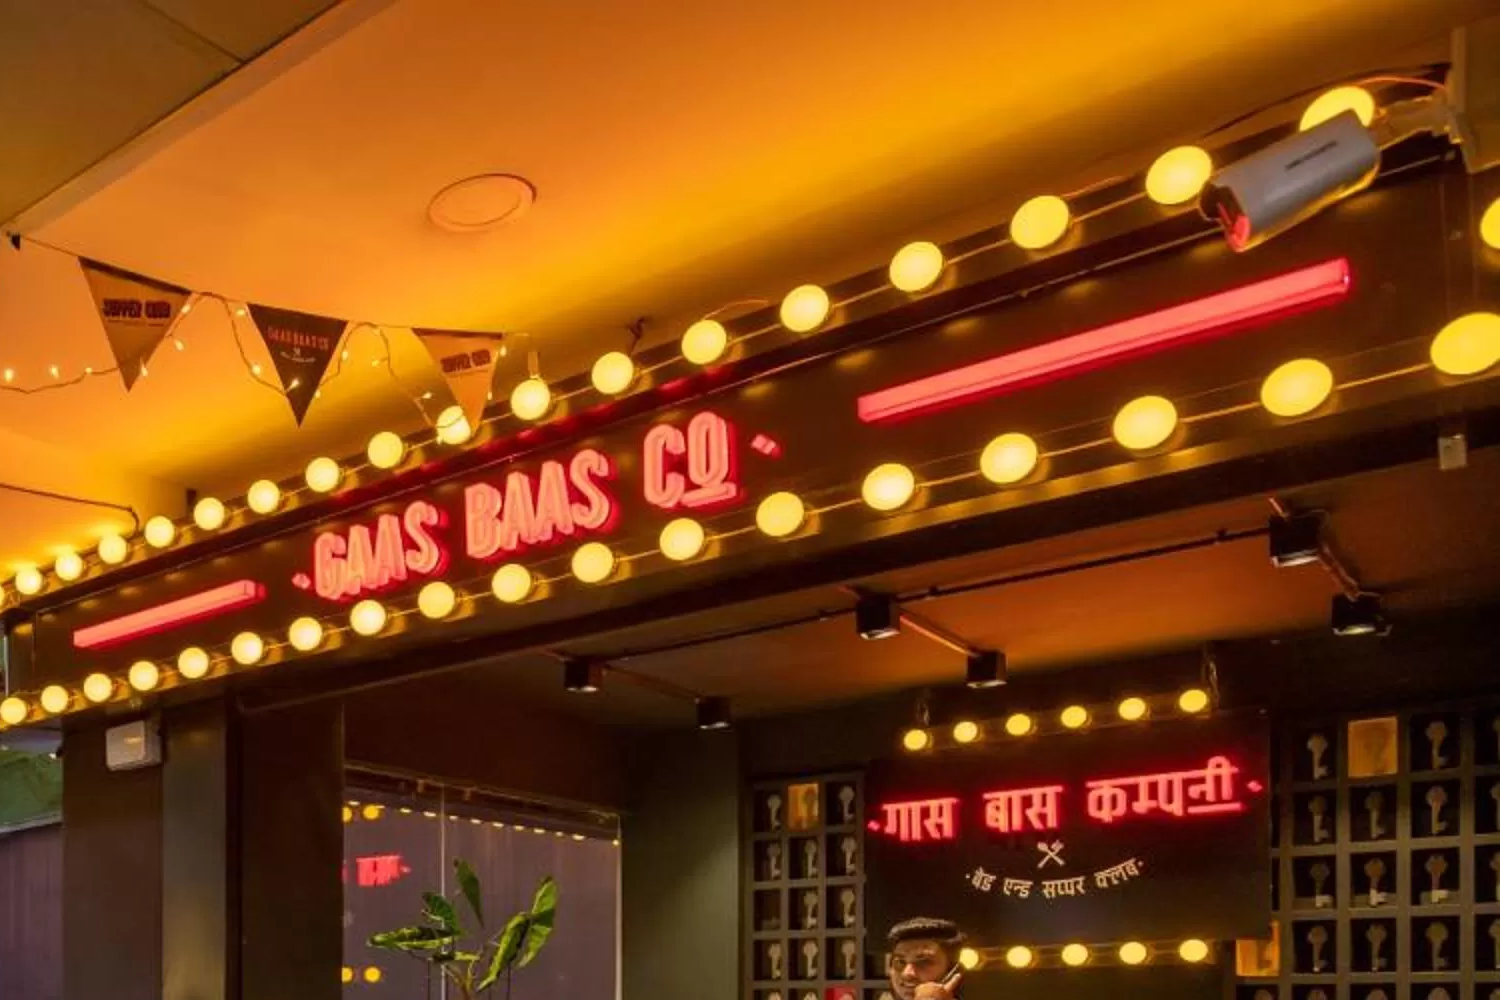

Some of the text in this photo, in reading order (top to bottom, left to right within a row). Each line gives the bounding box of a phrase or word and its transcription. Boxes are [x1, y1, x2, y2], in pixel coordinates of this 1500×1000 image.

[314, 410, 738, 600] GAAS BAAS CO
[881, 755, 1242, 841] गास बास कम्पनी
